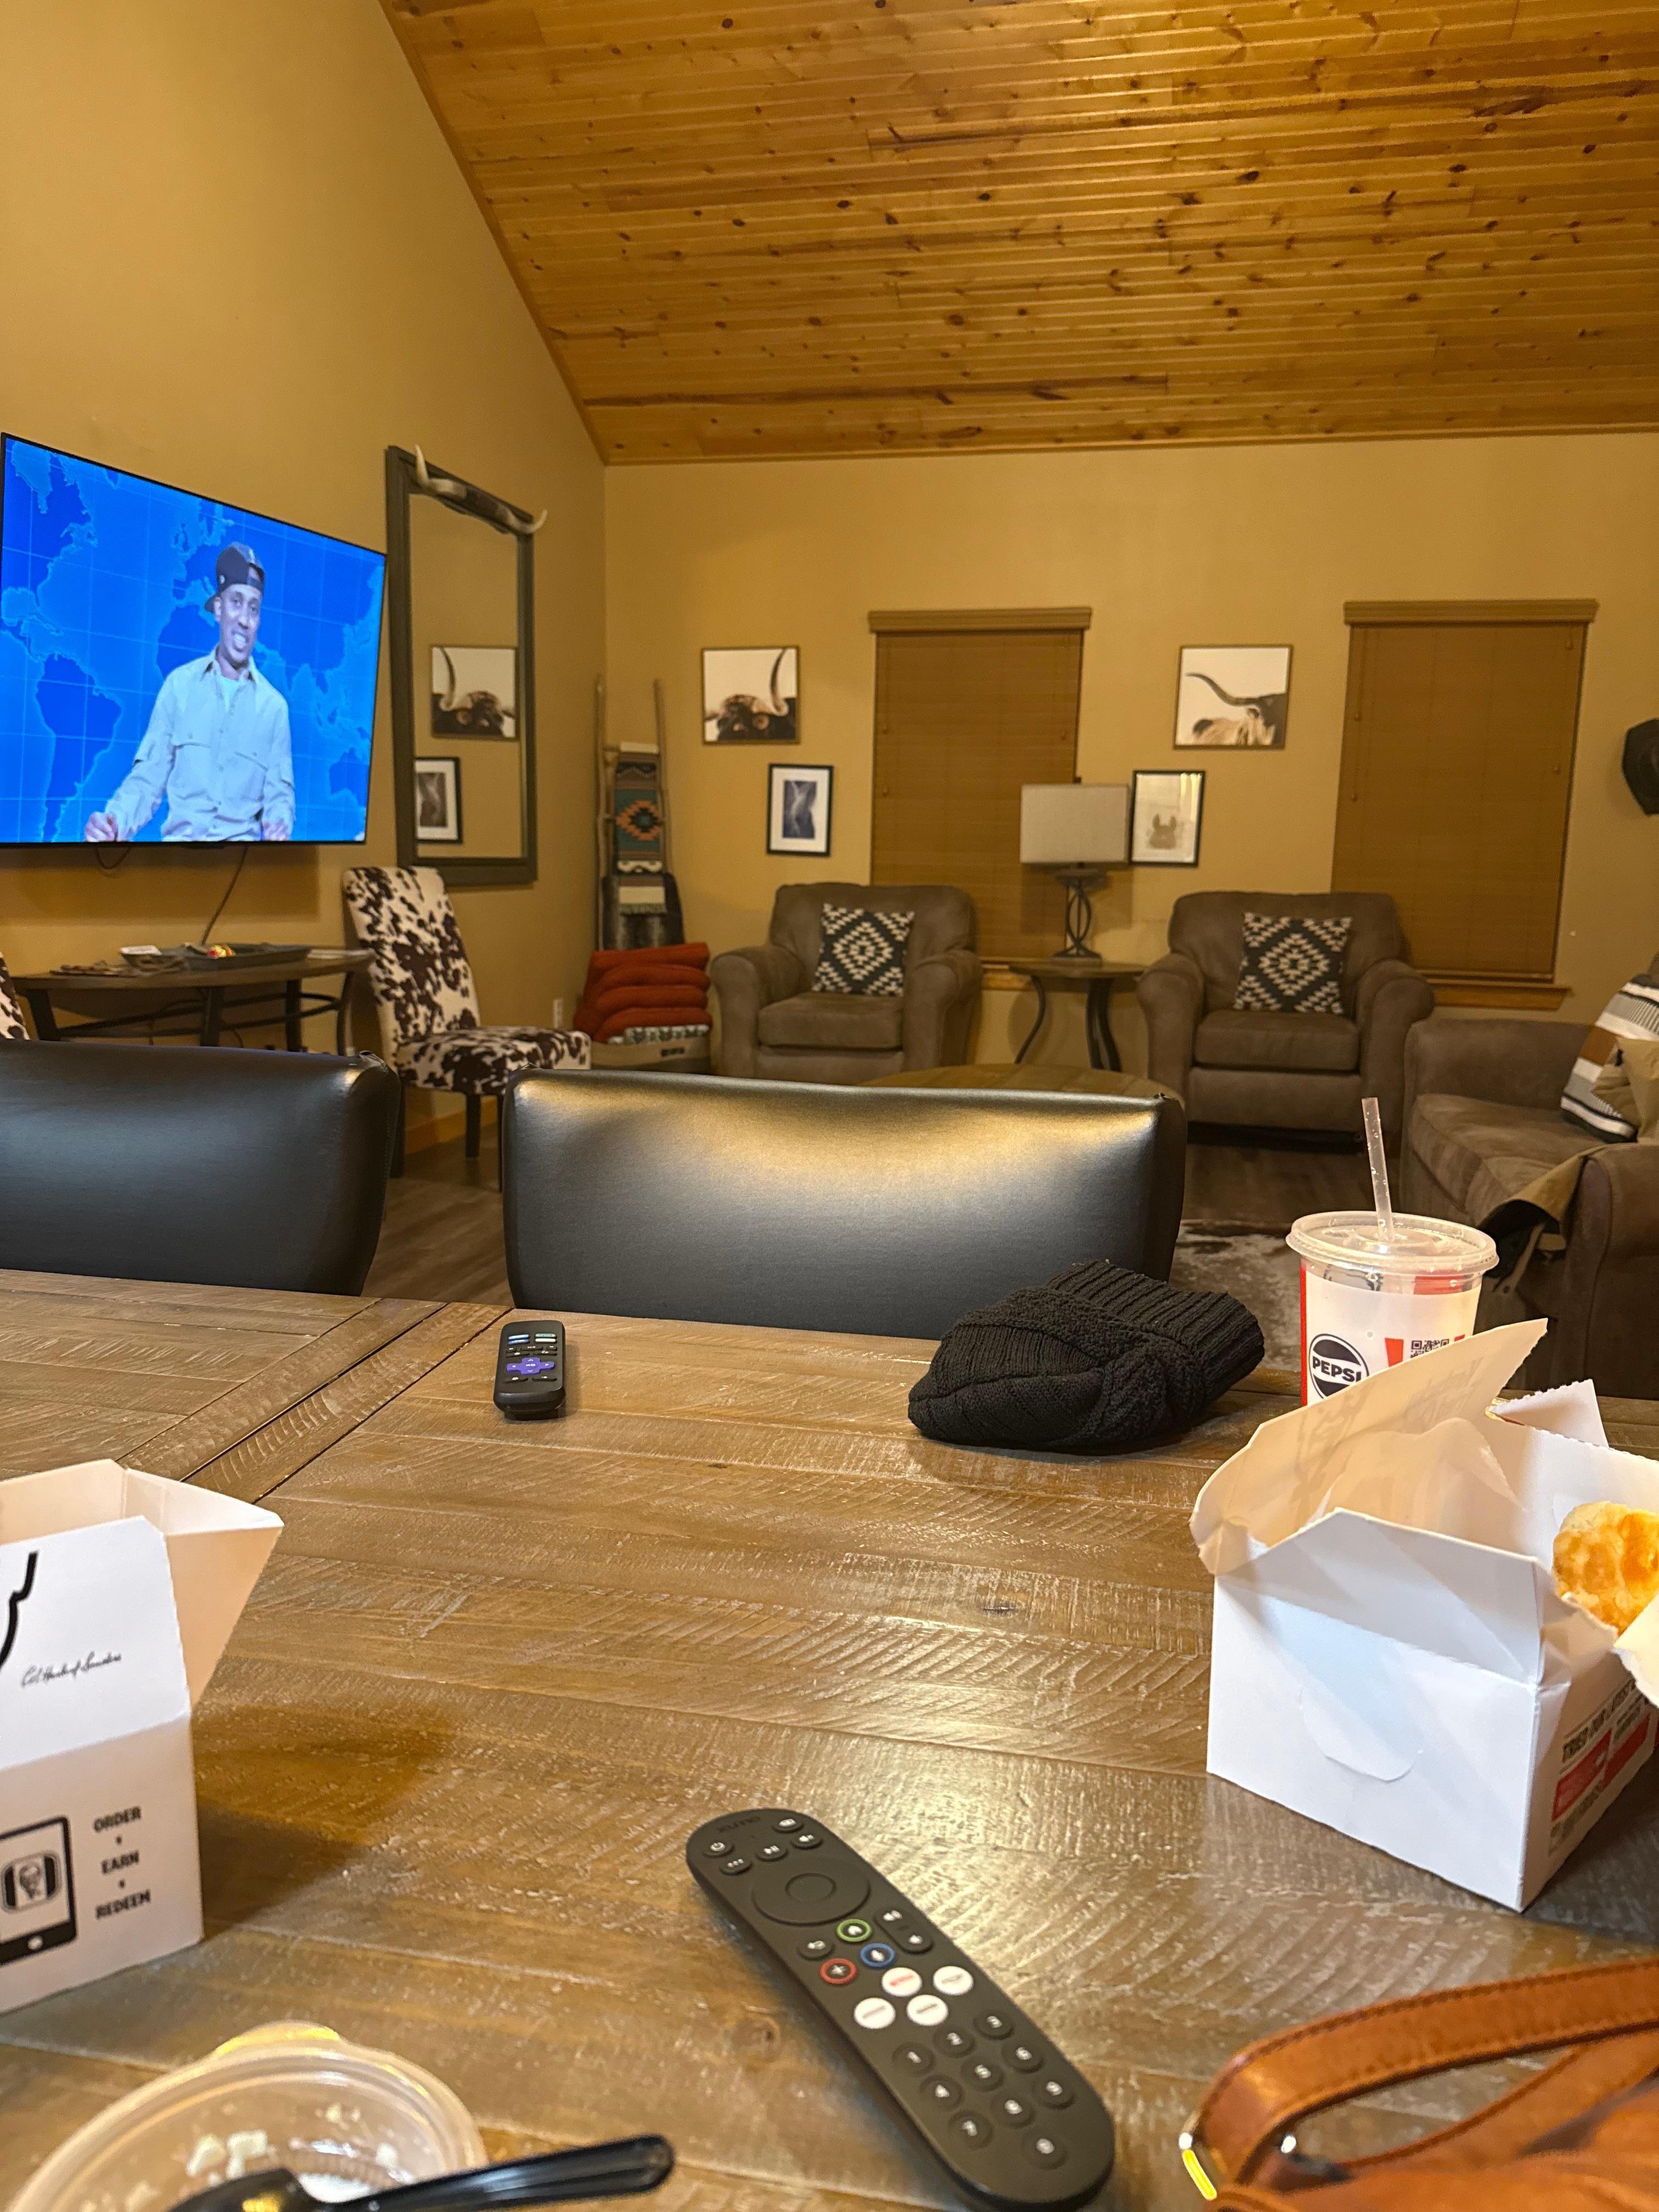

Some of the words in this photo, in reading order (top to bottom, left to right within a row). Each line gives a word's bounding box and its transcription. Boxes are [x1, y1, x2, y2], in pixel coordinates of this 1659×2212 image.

[1312, 1355, 1362, 1383] PEPSI
[94, 1806, 141, 1832] ORDER
[101, 1849, 139, 1874] EARN
[95, 1889, 150, 1919] REDEEM
